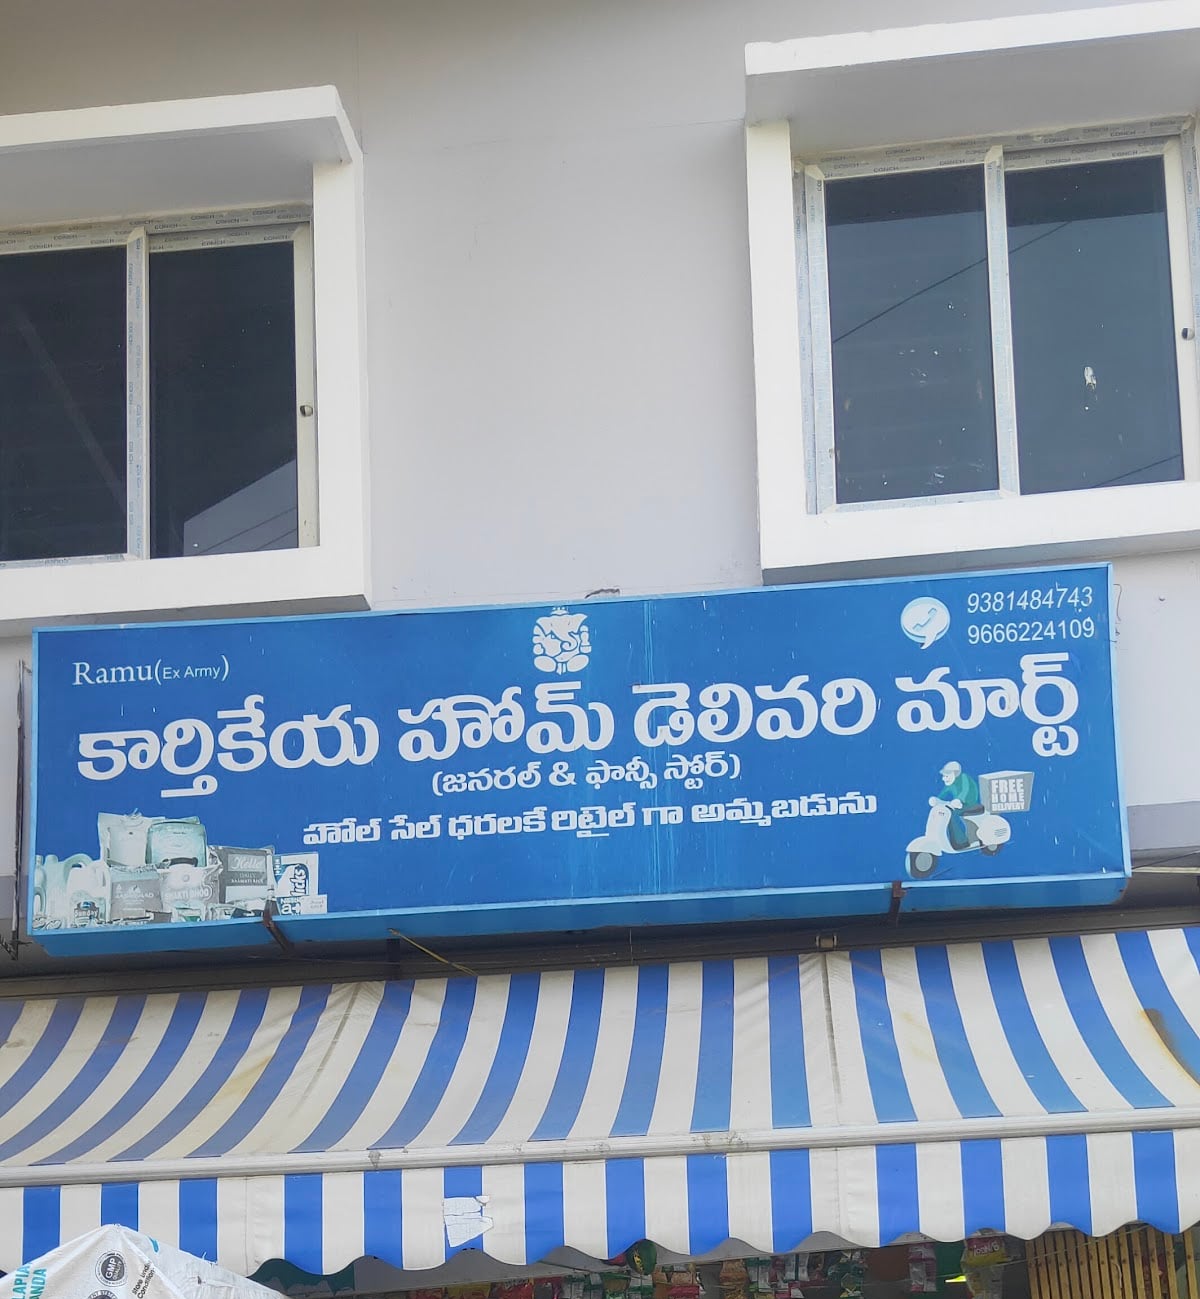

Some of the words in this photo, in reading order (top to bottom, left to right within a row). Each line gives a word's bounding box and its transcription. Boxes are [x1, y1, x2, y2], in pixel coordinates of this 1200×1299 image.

[967, 586, 1093, 614] 9381484743
[967, 618, 1095, 646] 9666224109
[77, 694, 380, 798] కార్తికేయ
[397, 680, 615, 763] హోమ్
[632, 674, 877, 748] డెలివరి
[895, 652, 1079, 757] మార్ట్
[548, 761, 577, 787] &
[991, 778, 1024, 794] FREE
[991, 792, 1025, 804] HOME
[991, 801, 1025, 812] DELIVERY
[388, 814, 442, 840] సేల్
[641, 805, 684, 826] గా
[106, 1257, 118, 1279] GMP
